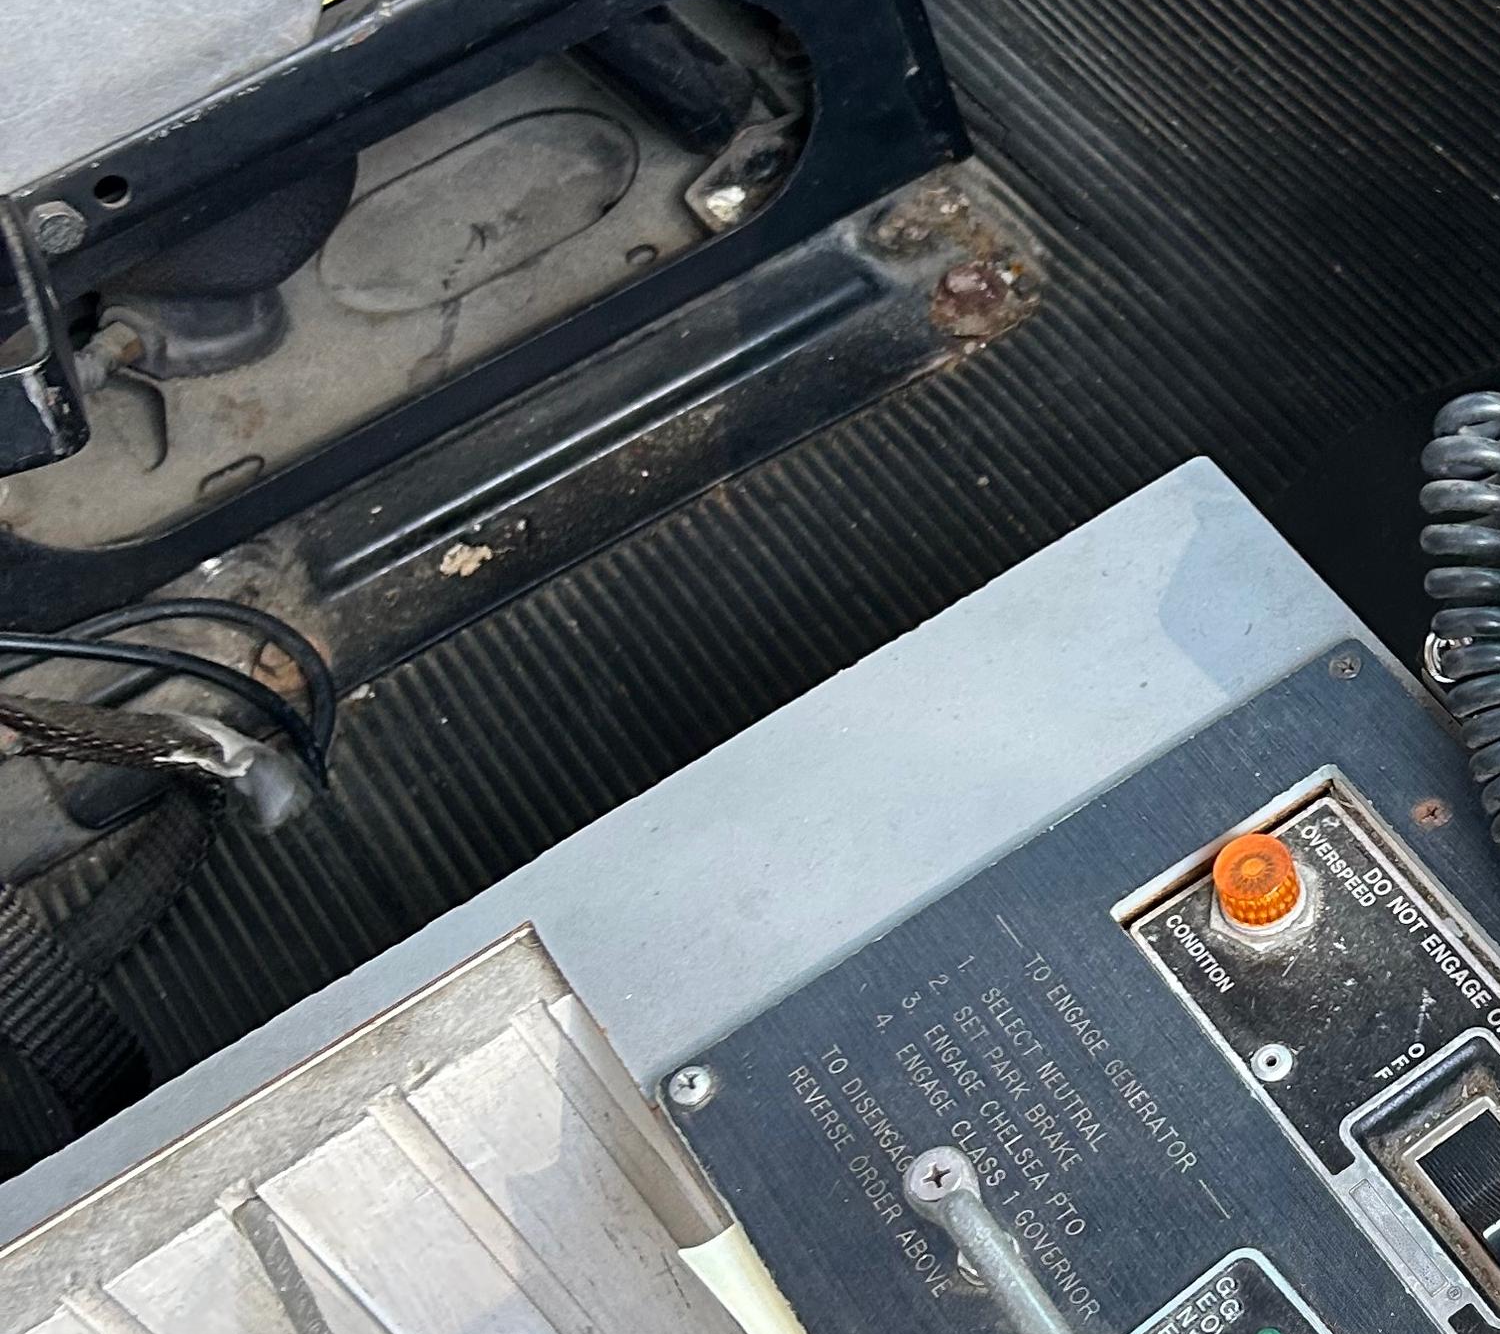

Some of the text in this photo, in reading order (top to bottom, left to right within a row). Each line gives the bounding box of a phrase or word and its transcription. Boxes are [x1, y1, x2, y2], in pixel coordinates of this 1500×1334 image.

[1166, 915, 1234, 992] CONDITION
[1300, 825, 1376, 906] OVERSPEED
[1363, 868, 1392, 895] DO
[1386, 896, 1428, 932] NOT
[1421, 934, 1492, 1008] ENGAGE
[818, 1043, 919, 1175] TO DISENGAG
[899, 989, 1088, 1238] 3. ENGAGE CHELSEA PTO
[927, 971, 1083, 1173] 2. SET PARK BRAKE
[955, 953, 1112, 1154] 1. SELECT NEUTRAL
[1022, 952, 1199, 1174] TO ENGAGE GENERATOR
[1372, 1039, 1427, 1084] OFF
[787, 1064, 955, 1299] REVERSE ORDER ABOVE
[871, 1008, 1103, 1324] 4. ENGAGE CLASS 1 GOVERNOR
